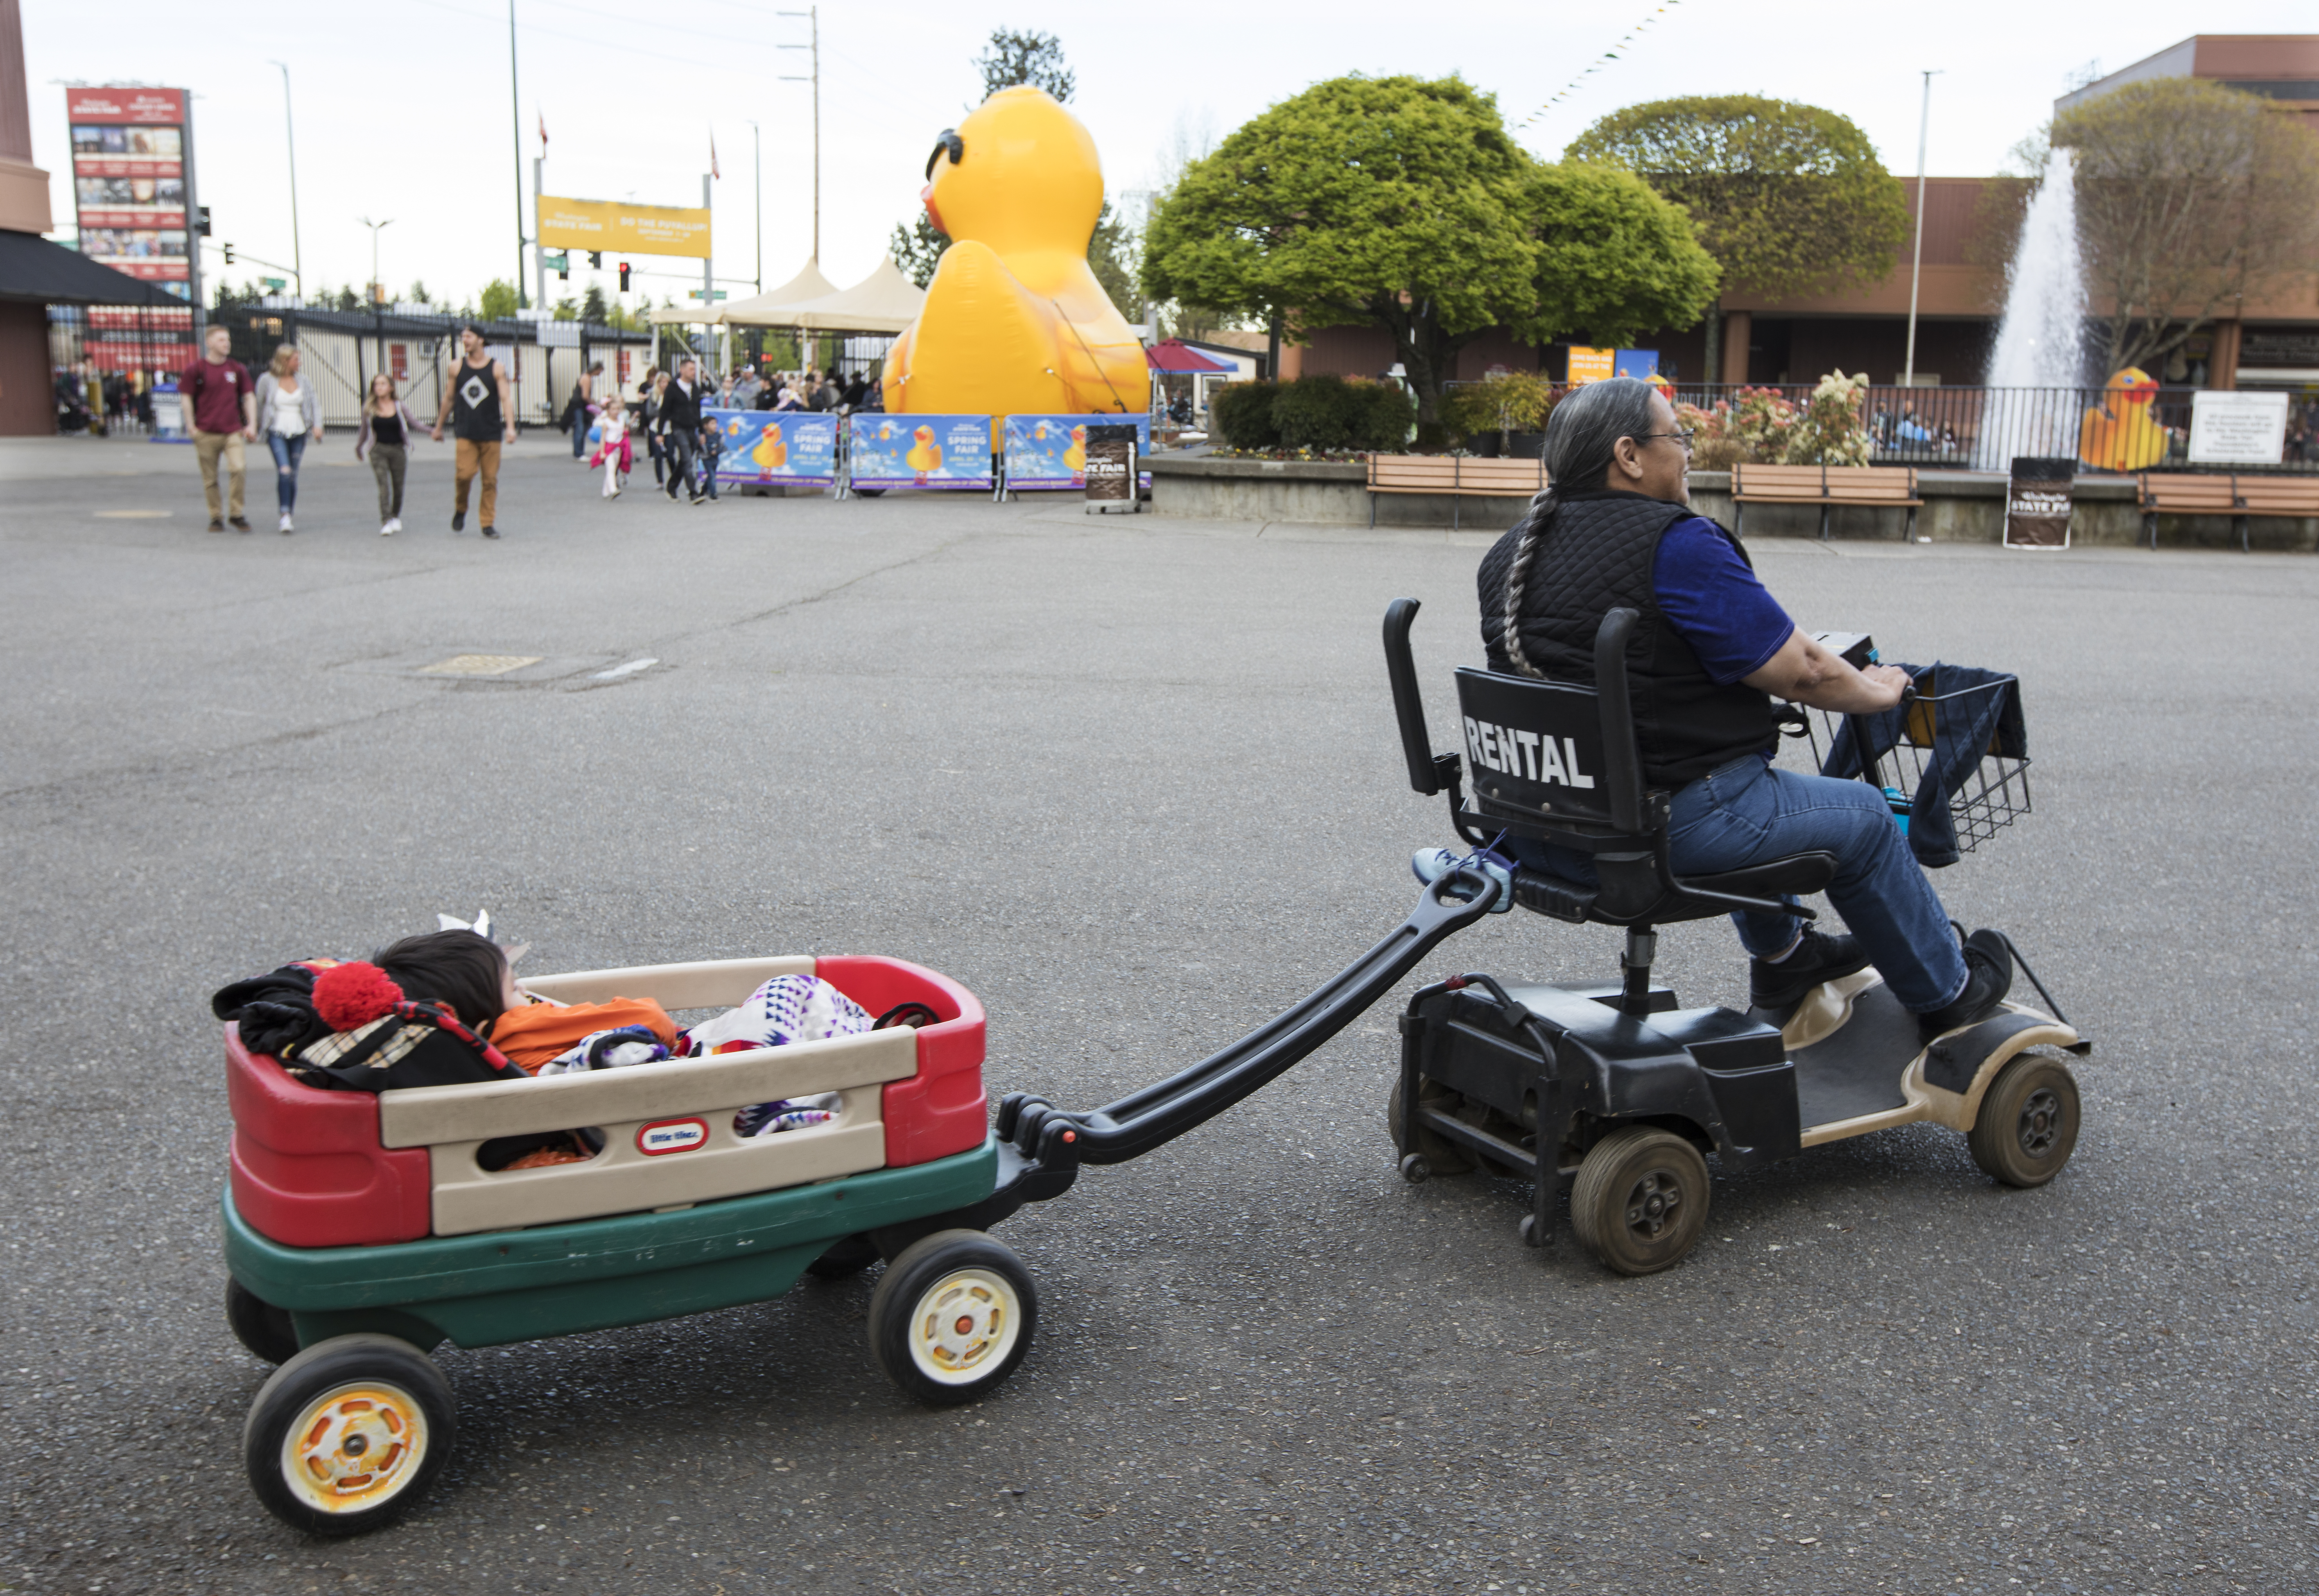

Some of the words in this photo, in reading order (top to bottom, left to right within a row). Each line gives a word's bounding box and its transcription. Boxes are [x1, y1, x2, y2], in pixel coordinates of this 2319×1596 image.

[544, 219, 576, 230] STATE
[578, 222, 603, 231] FAIR
[620, 217, 635, 227] DO
[638, 218, 655, 228] THE
[657, 220, 708, 232] PUYALLUP!
[793, 434, 831, 445] SPRING
[948, 436, 986, 445] SPRING
[800, 443, 823, 453] FAIR
[955, 445, 979, 454] FAIR
[1099, 464, 1126, 473] FAIR
[2011, 500, 2050, 512] STATE
[1463, 715, 1595, 789] RENTAL
